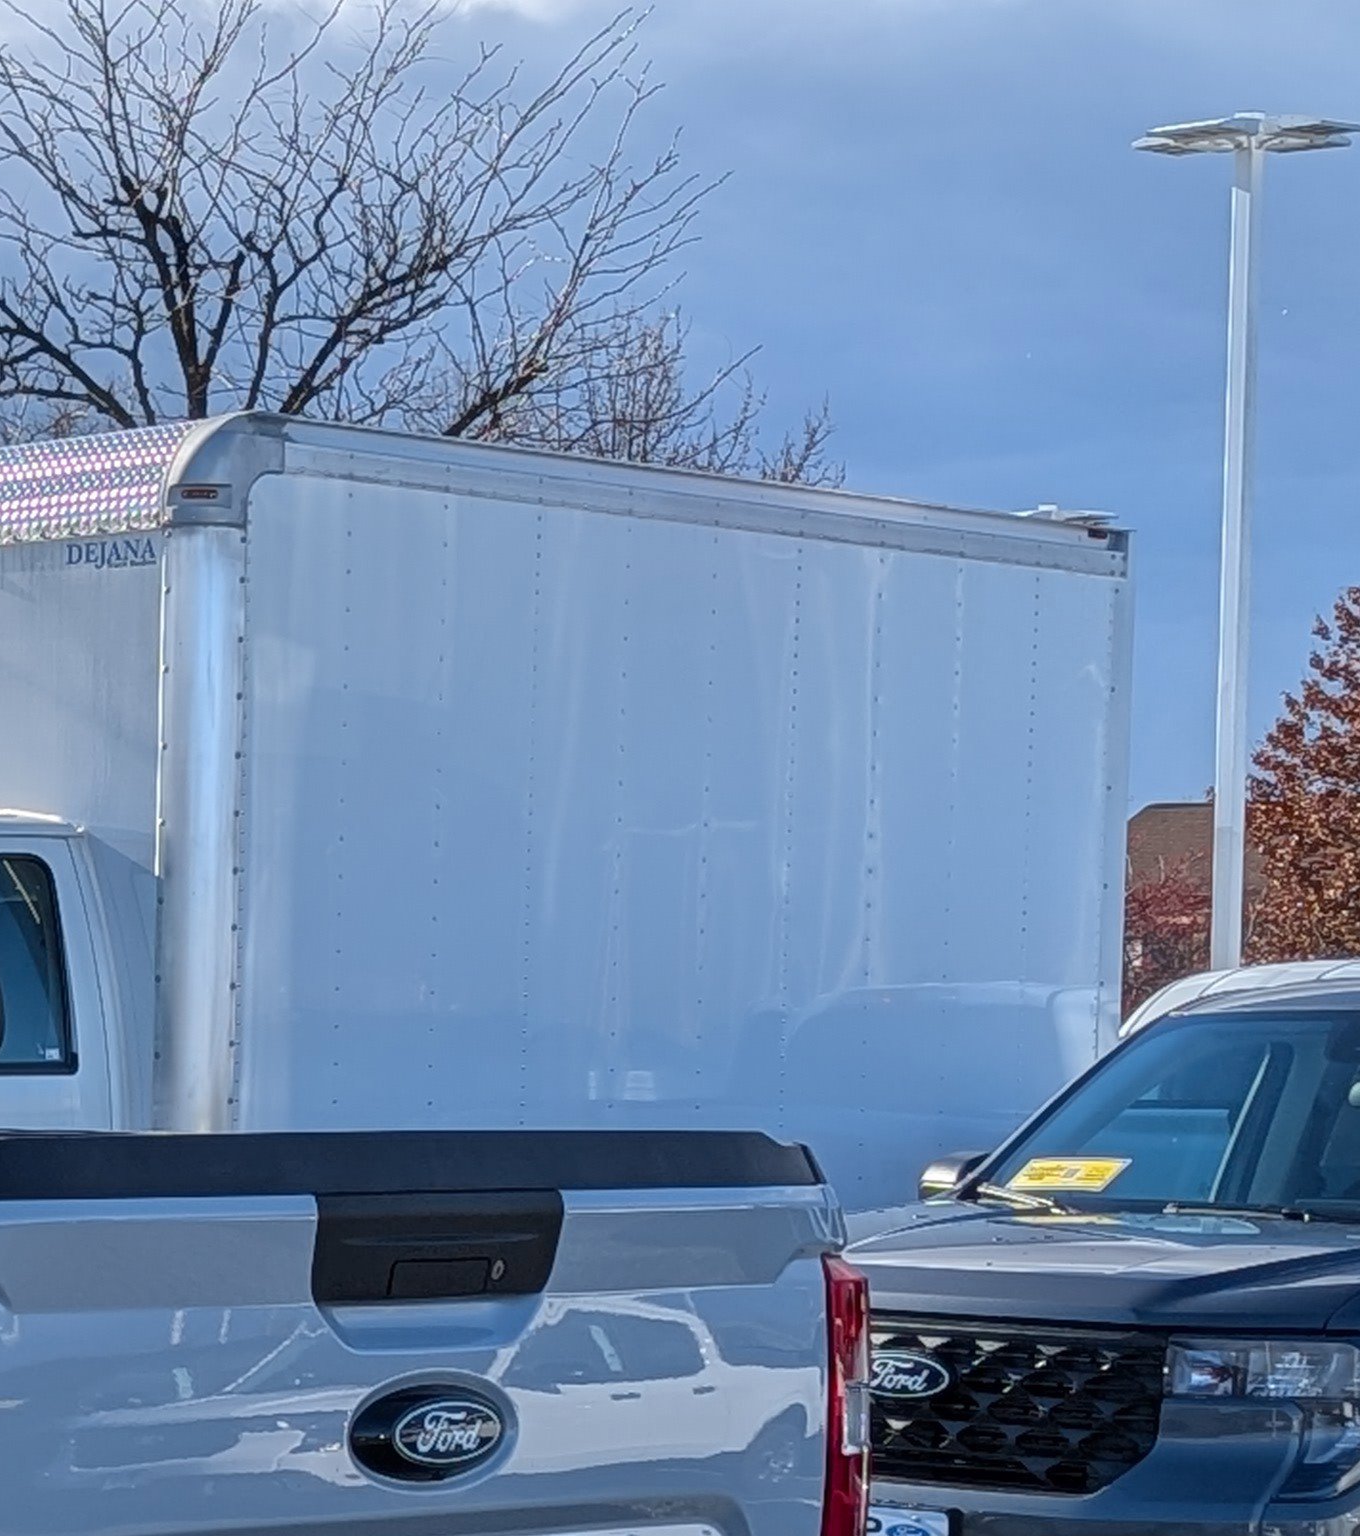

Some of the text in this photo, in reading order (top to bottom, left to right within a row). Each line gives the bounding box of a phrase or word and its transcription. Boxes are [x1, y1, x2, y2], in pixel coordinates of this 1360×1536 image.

[66, 539, 156, 569] DEJANA
[870, 1359, 930, 1391] Ford
[416, 1411, 483, 1453] Ford
